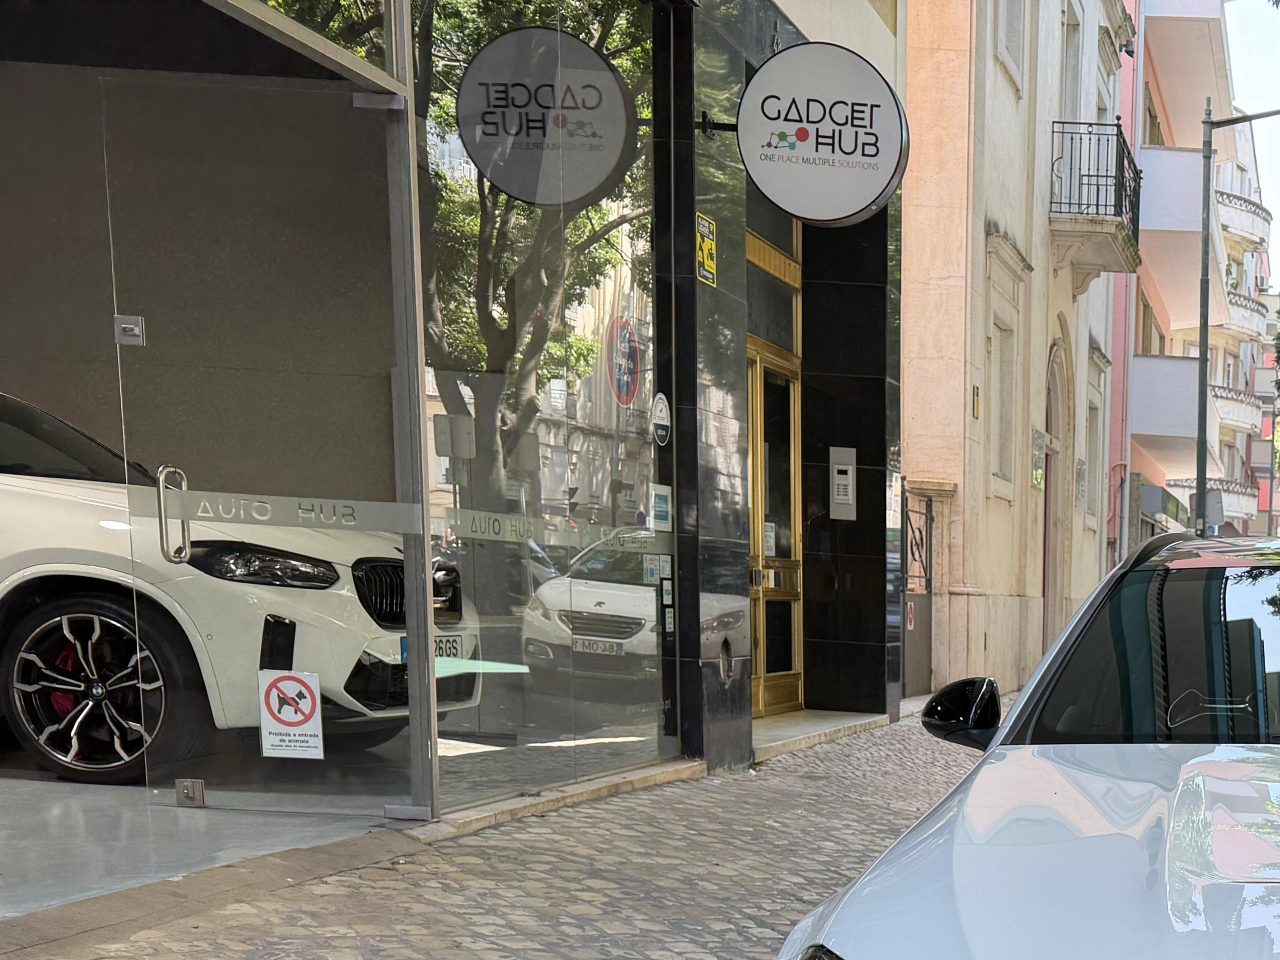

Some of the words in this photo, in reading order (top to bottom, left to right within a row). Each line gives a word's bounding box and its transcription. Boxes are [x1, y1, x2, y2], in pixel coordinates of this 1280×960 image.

[760, 94, 881, 129] GADGET
[815, 127, 880, 158] HUB
[759, 153, 776, 162] ONE
[777, 154, 801, 164] PLACE
[801, 156, 837, 167] MULTIPLE
[837, 159, 879, 171] SOLUTIONS
[196, 498, 272, 521] AUTO
[297, 502, 358, 526] HUB
[470, 515, 502, 536] AUTO
[510, 520, 533, 538] HUB
